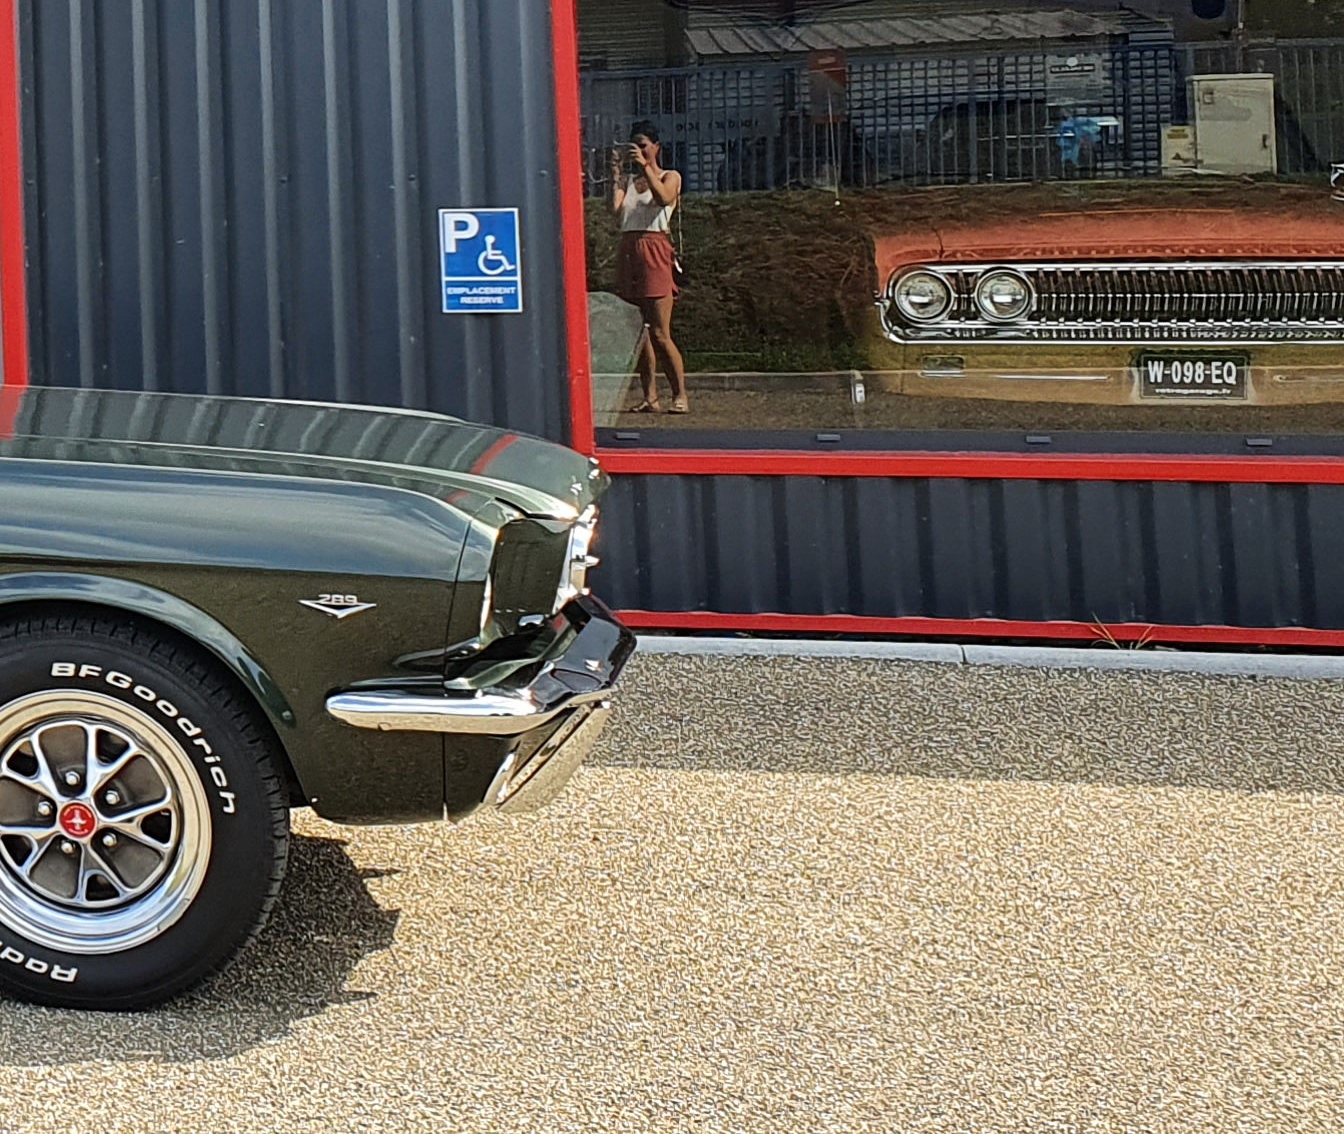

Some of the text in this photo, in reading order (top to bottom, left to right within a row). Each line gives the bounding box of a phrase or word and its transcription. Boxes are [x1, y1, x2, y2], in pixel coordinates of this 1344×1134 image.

[443, 212, 480, 254] P
[446, 287, 517, 295] EMPLACEMENT
[1147, 360, 1237, 385] W-098-EQ
[317, 593, 359, 605] 289
[50, 662, 236, 814] BFGoodrich
